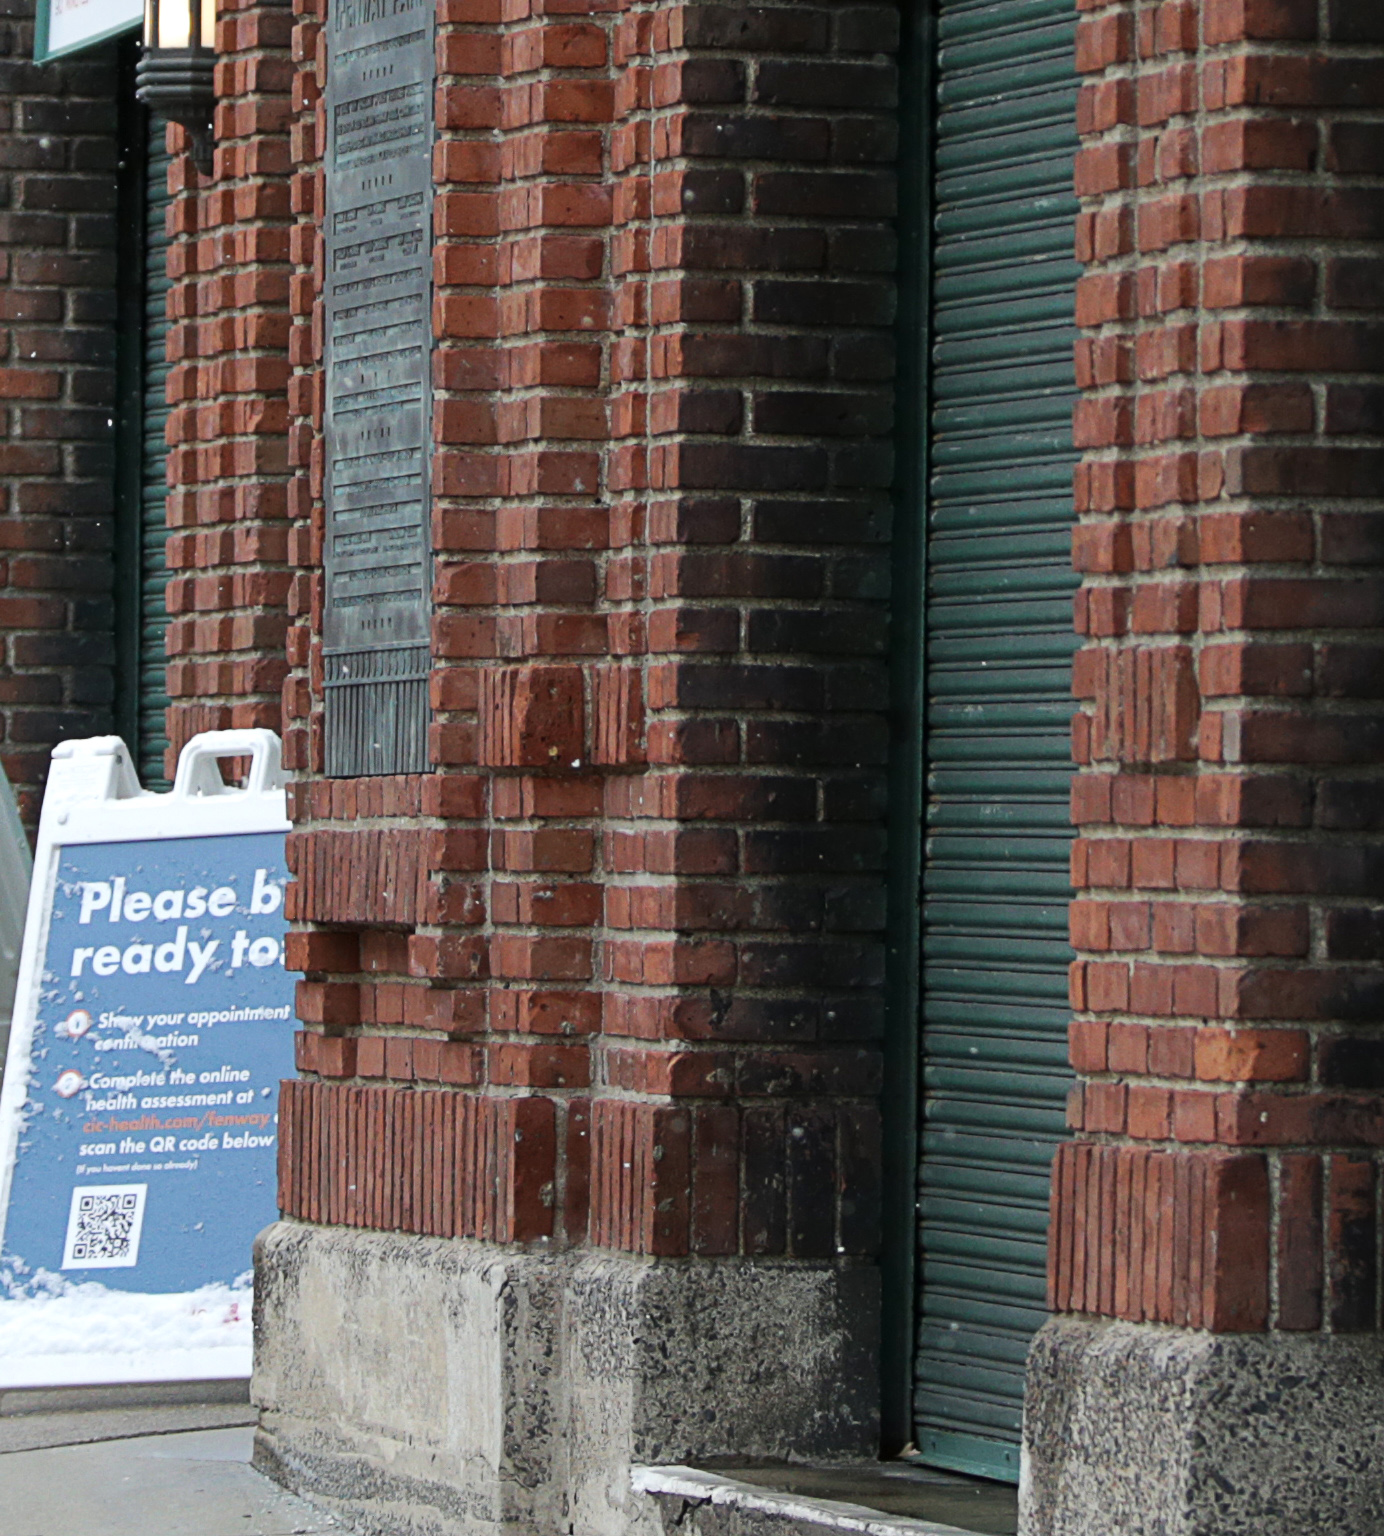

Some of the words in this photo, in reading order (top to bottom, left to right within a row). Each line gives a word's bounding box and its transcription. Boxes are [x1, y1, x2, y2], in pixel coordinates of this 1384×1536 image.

[79, 876, 236, 924] Please
[250, 868, 285, 914] b
[70, 925, 220, 985] ready
[98, 1011, 144, 1029] Shw
[146, 1012, 186, 1031] your
[187, 1005, 290, 1028] appointment
[89, 1069, 166, 1090] Complete
[170, 1067, 196, 1084] the
[199, 1065, 250, 1083] online
[85, 1092, 137, 1112] health
[140, 1090, 233, 1109] assessment
[236, 1089, 254, 1104] at
[83, 1110, 271, 1133] cic-health.com/fenway
[79, 1143, 116, 1156] scan
[119, 1136, 146, 1154] the
[149, 1136, 176, 1153] QR
[179, 1132, 219, 1151] code
[222, 1131, 275, 1149] below
